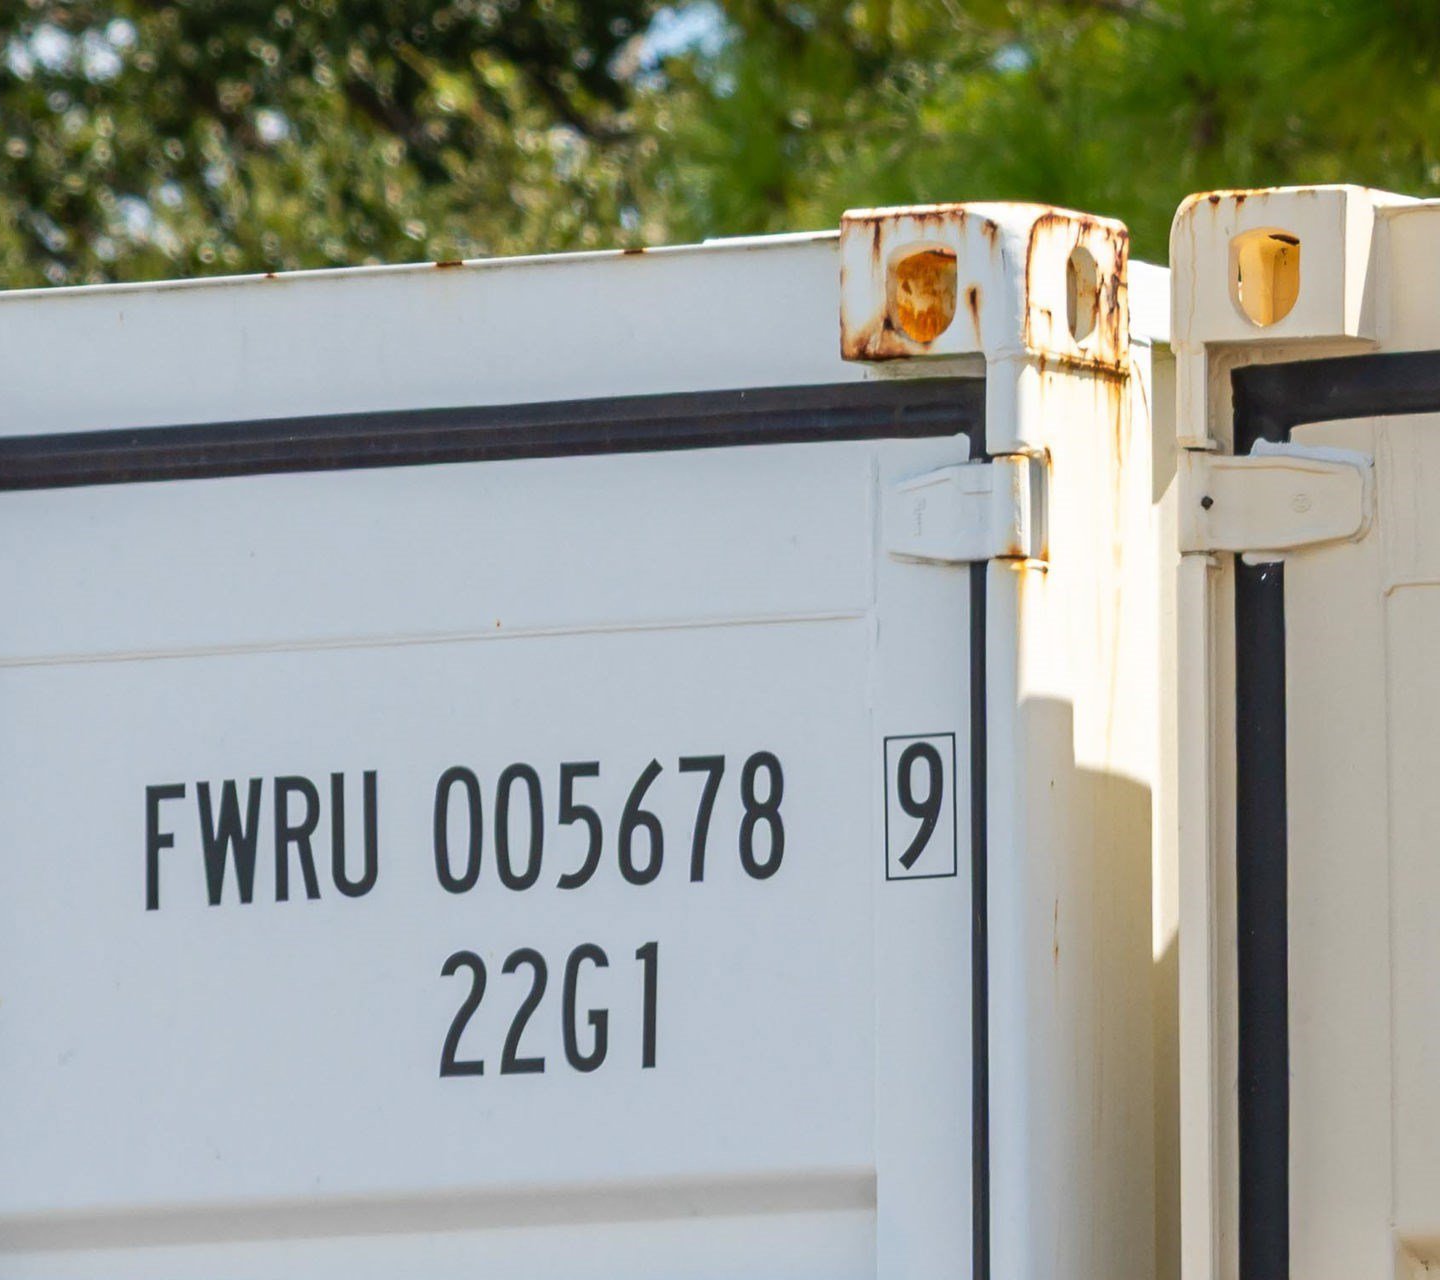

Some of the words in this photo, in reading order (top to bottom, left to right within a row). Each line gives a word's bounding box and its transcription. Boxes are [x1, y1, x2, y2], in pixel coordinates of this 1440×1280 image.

[144, 769, 379, 910] FWRU
[432, 750, 786, 895] 005678
[896, 741, 945, 871] 9
[438, 940, 660, 1078] 22G1
